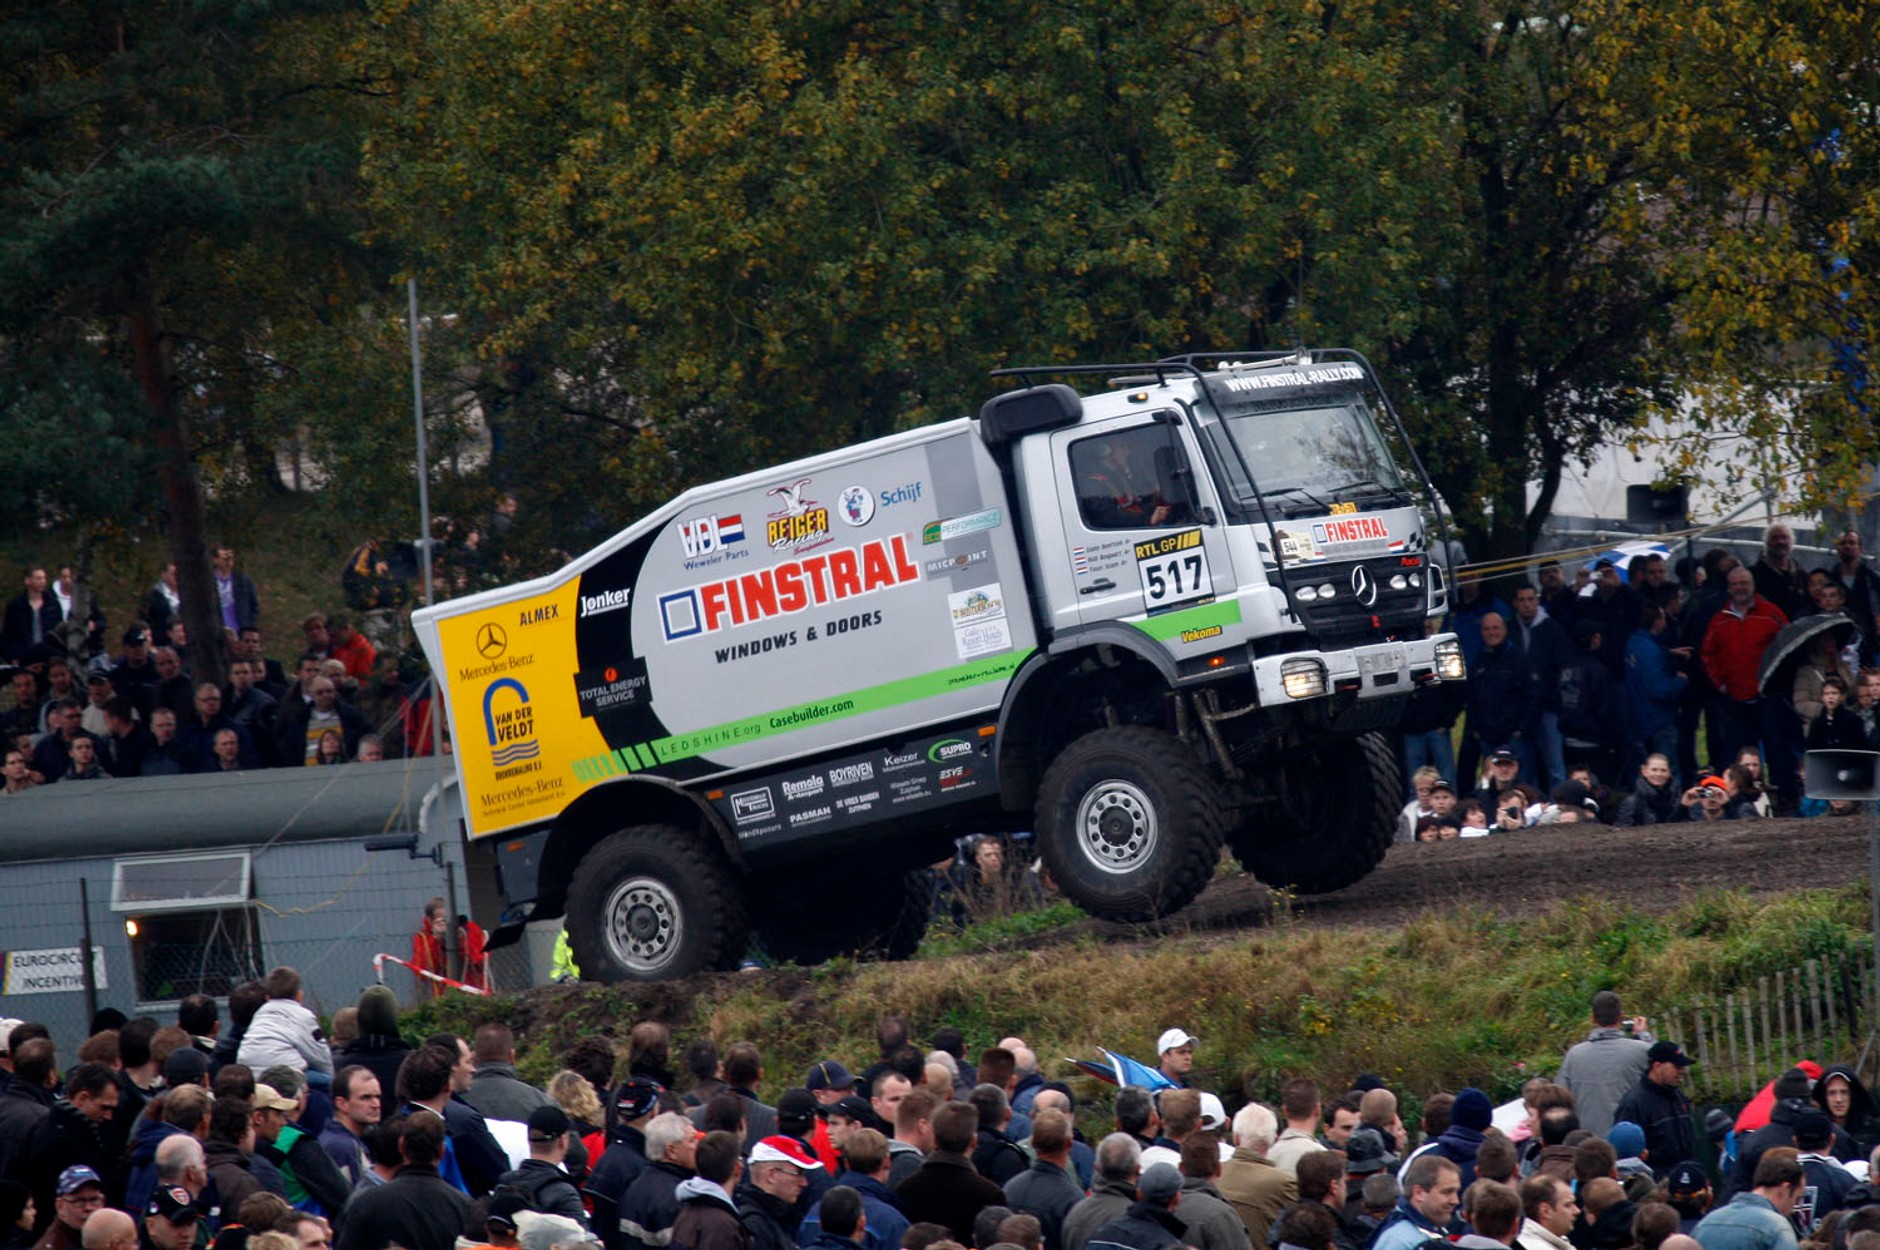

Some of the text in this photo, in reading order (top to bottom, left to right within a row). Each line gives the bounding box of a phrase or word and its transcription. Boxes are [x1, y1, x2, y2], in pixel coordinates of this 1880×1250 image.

[1225, 367, 1364, 392] WWW.FINSTRAL-RALLY.COM
[881, 481, 922, 507] Schijf
[677, 514, 728, 558] VDL
[767, 508, 829, 548] REIGER
[1325, 518, 1389, 542] FINSTRAL
[725, 550, 749, 563] Parts
[1135, 543, 1160, 559] RTL
[1160, 537, 1177, 552] GP
[1283, 541, 1298, 552] 544
[700, 535, 919, 632] FINSTRAL
[1146, 554, 1203, 600] 517
[580, 588, 630, 618] Jonker
[520, 604, 559, 627] ALMEX
[715, 610, 882, 663] WINDOWS & DOORS
[1182, 625, 1221, 643] Vekoma
[459, 654, 535, 682] Mercedes-Benz
[580, 676, 647, 700] TOTAL ENERGY
[596, 690, 634, 706] SERVICE
[495, 706, 533, 726] VAN DER
[769, 700, 854, 729] Casebuilder.com
[497, 719, 534, 742] VELDT
[884, 752, 919, 766] Keizer
[940, 742, 972, 756] SUPRO
[829, 762, 873, 782] BOYRIVEN
[481, 777, 564, 807] Mercedes-Benz
[782, 775, 824, 793] Remola
[789, 806, 831, 823] PASMAN
[14, 952, 94, 968] EUROCIRC
[23, 975, 85, 988] INCENTIV
